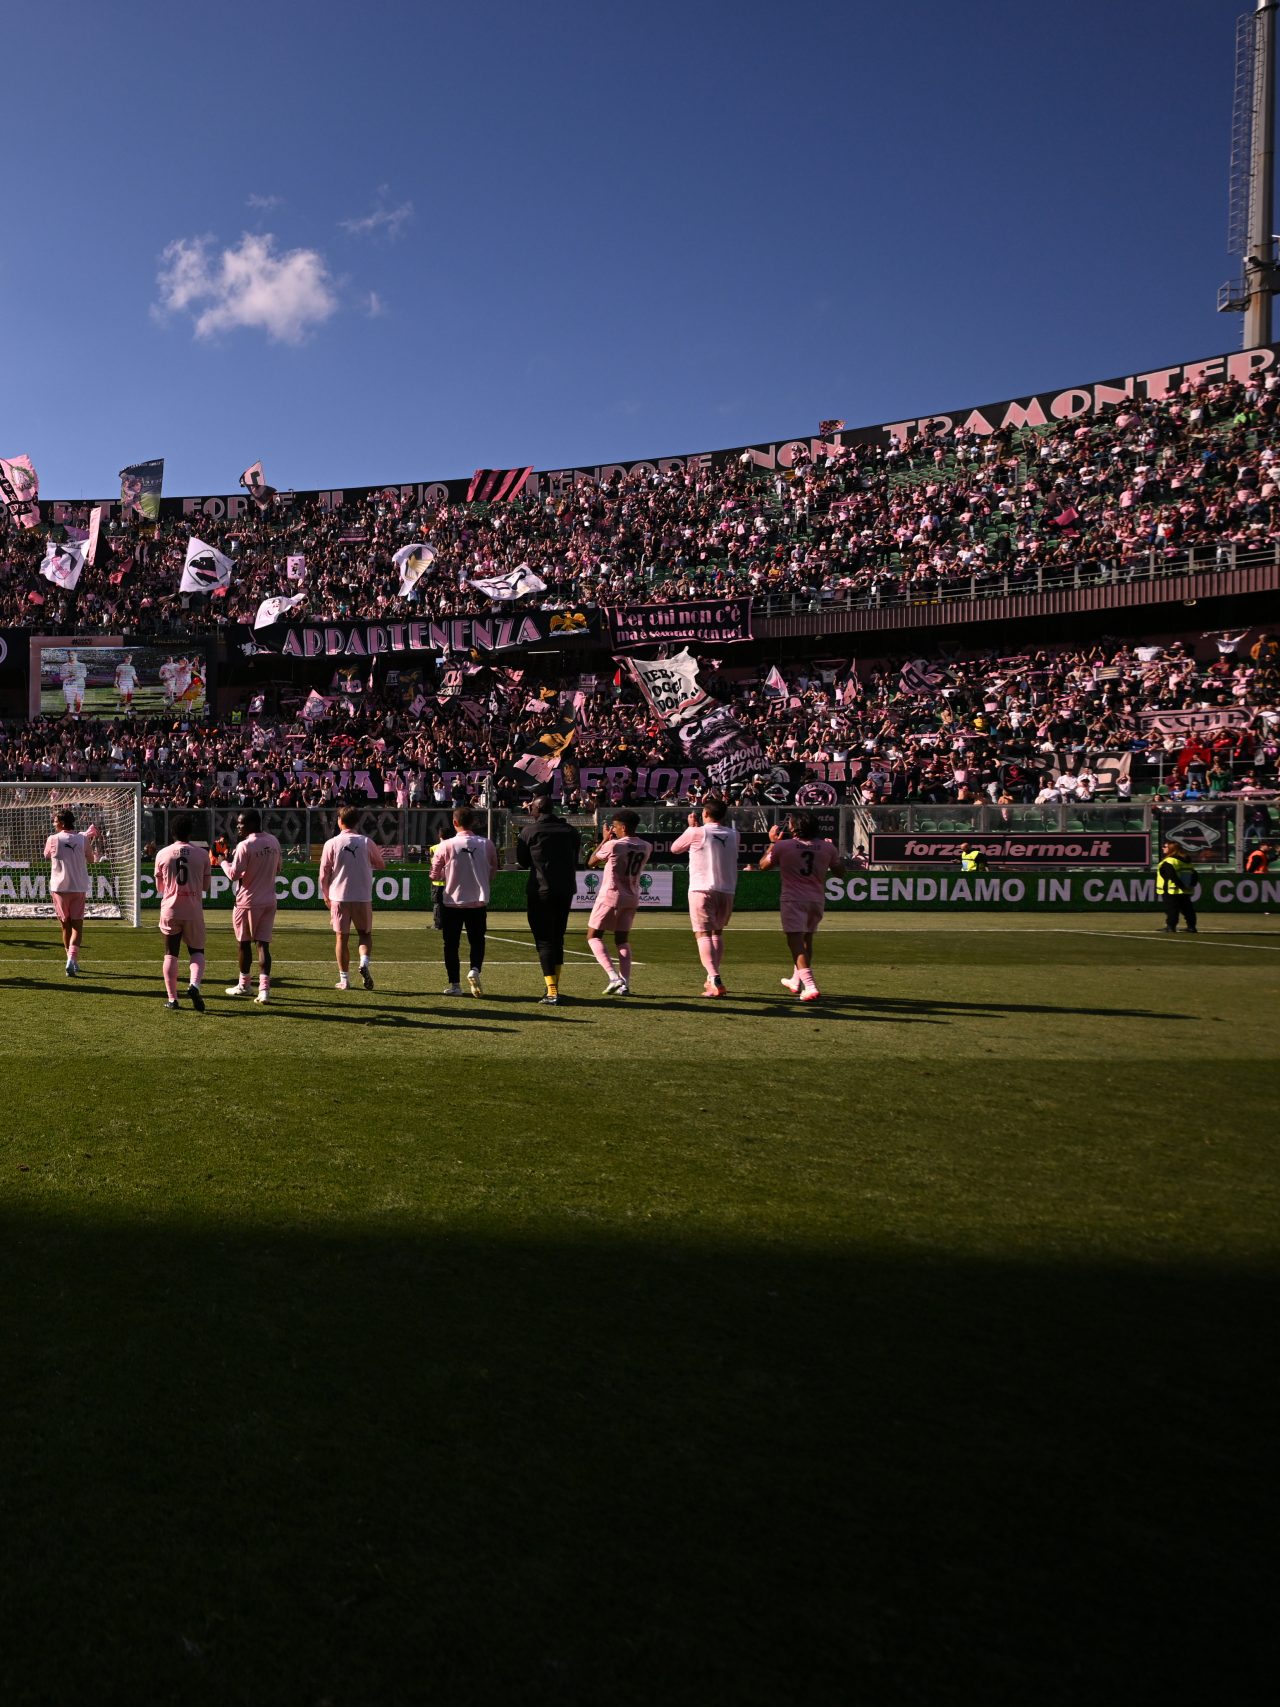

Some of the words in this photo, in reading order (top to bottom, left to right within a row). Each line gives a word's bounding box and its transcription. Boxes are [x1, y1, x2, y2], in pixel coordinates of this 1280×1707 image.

[183, 494, 293, 519] FORE
[747, 434, 841, 472] NON
[883, 348, 1278, 439] TRAMONTER
[649, 609, 676, 626] chi
[679, 609, 712, 625] non
[281, 616, 542, 657] APPARTENENZA
[616, 630, 638, 642] ma
[697, 628, 720, 640] con
[722, 625, 742, 639] noi
[711, 756, 771, 785] MEZZAGN
[176, 857, 188, 886] 6
[625, 850, 645, 876] 18
[800, 851, 814, 876] 3
[825, 877, 1026, 903] SCENDIAMO
[1038, 878, 1071, 901] IN
[1083, 879, 1202, 903] CAM
[1213, 879, 1280, 904] CON
